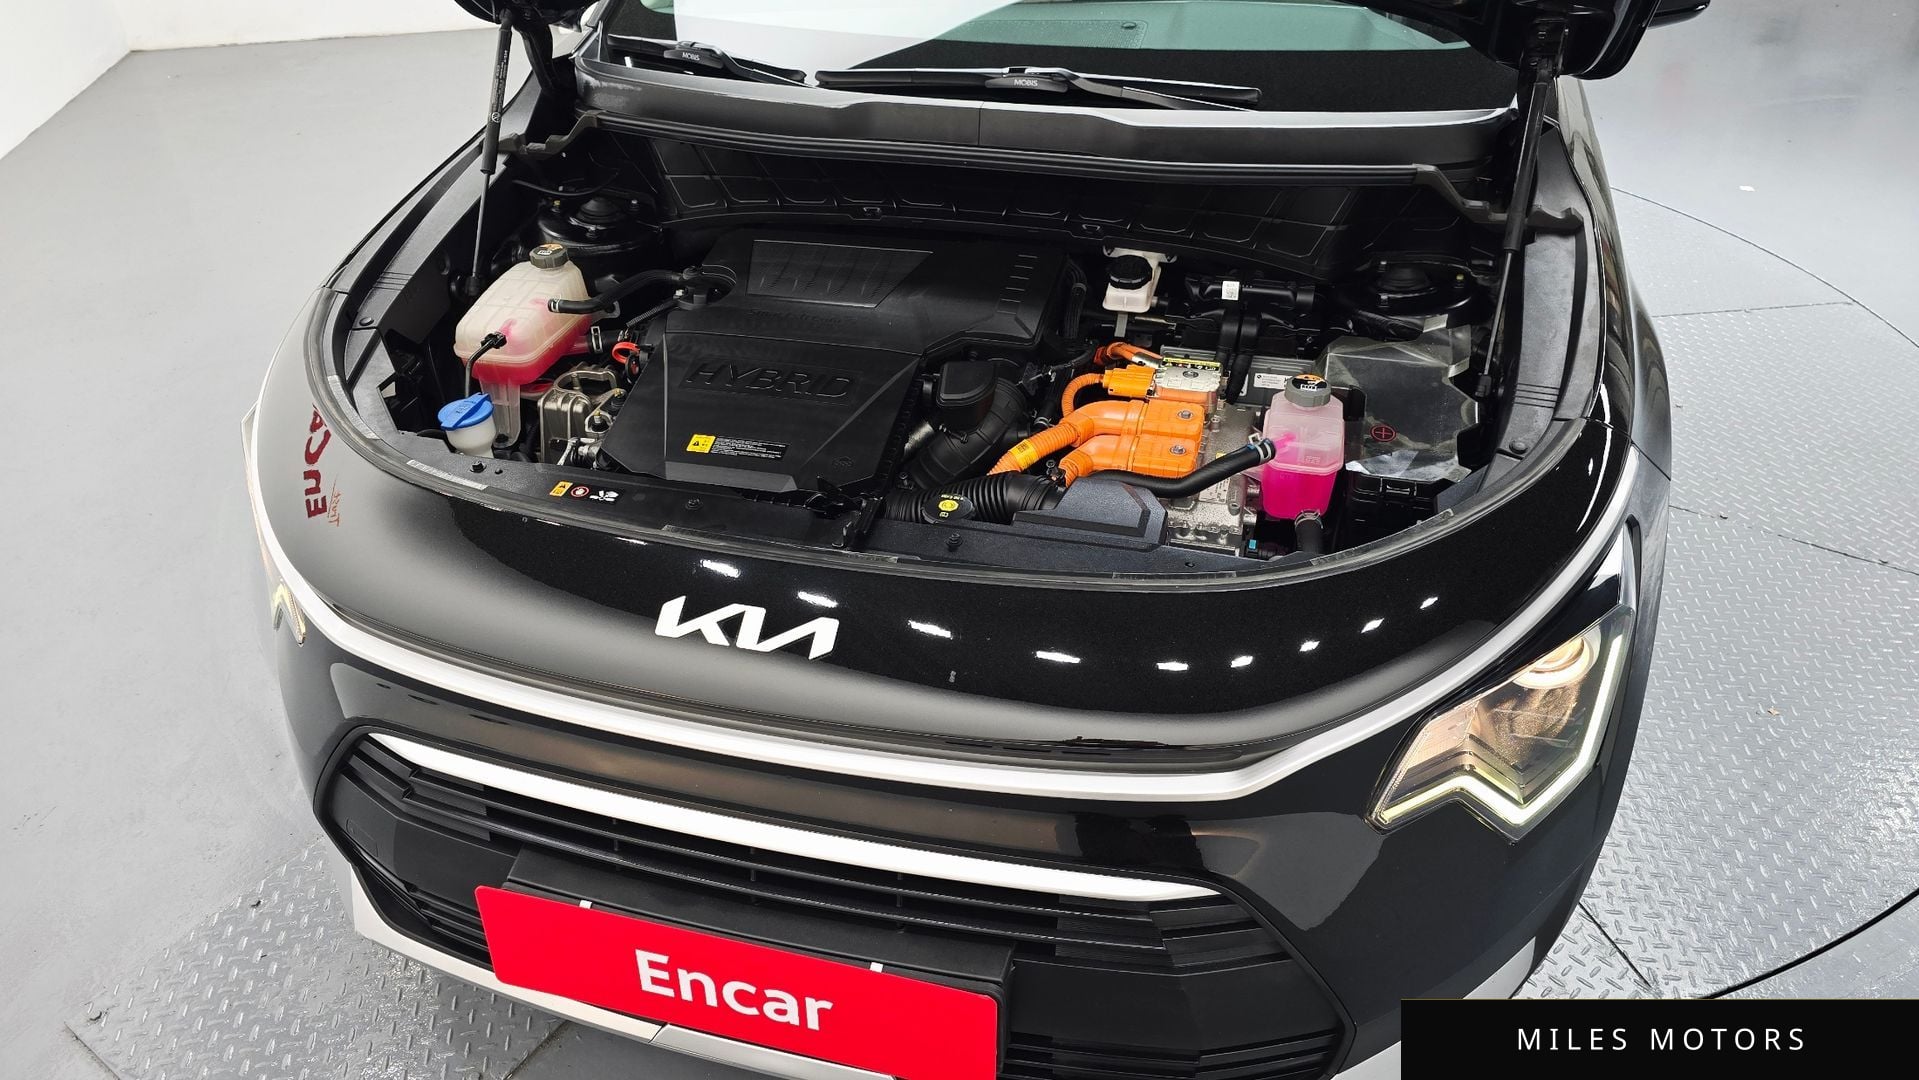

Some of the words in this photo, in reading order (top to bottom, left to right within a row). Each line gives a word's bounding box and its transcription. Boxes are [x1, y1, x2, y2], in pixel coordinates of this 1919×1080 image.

[1013, 79, 1038, 87] MOBIS
[686, 363, 854, 398] HYBRID
[634, 949, 834, 1031] Encar
